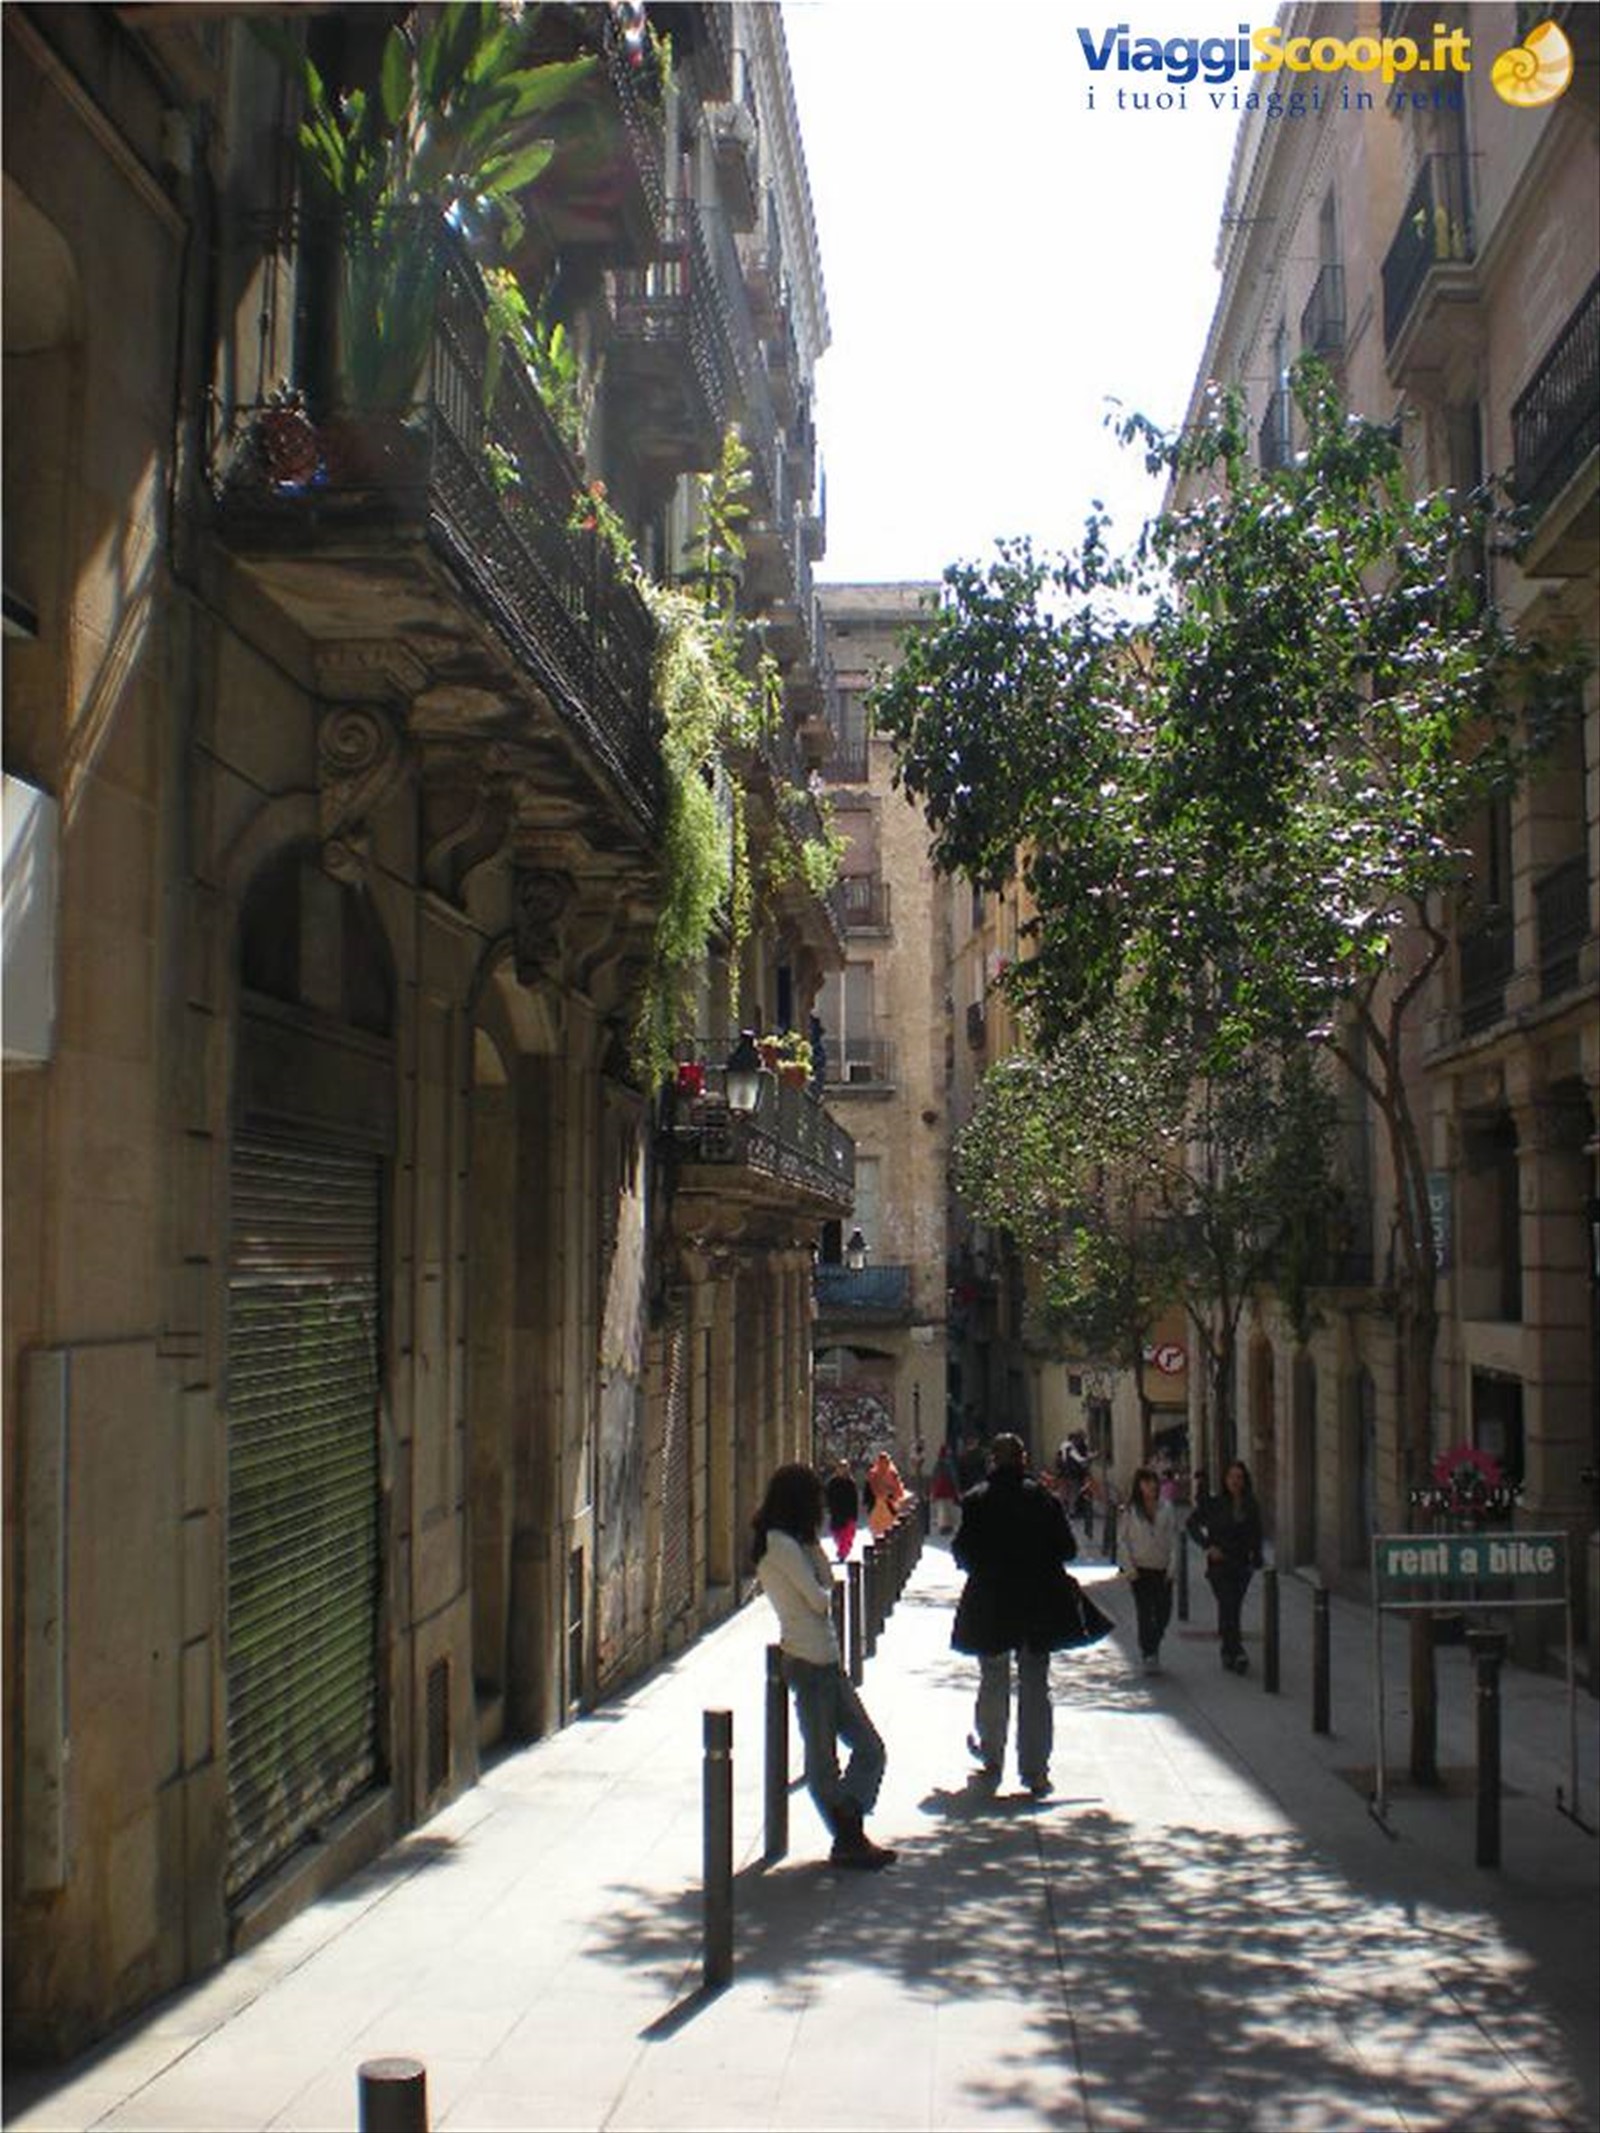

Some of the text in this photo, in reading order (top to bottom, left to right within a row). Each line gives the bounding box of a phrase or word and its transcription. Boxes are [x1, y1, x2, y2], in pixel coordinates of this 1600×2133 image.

[1387, 1541, 1555, 1574] rent a bike
